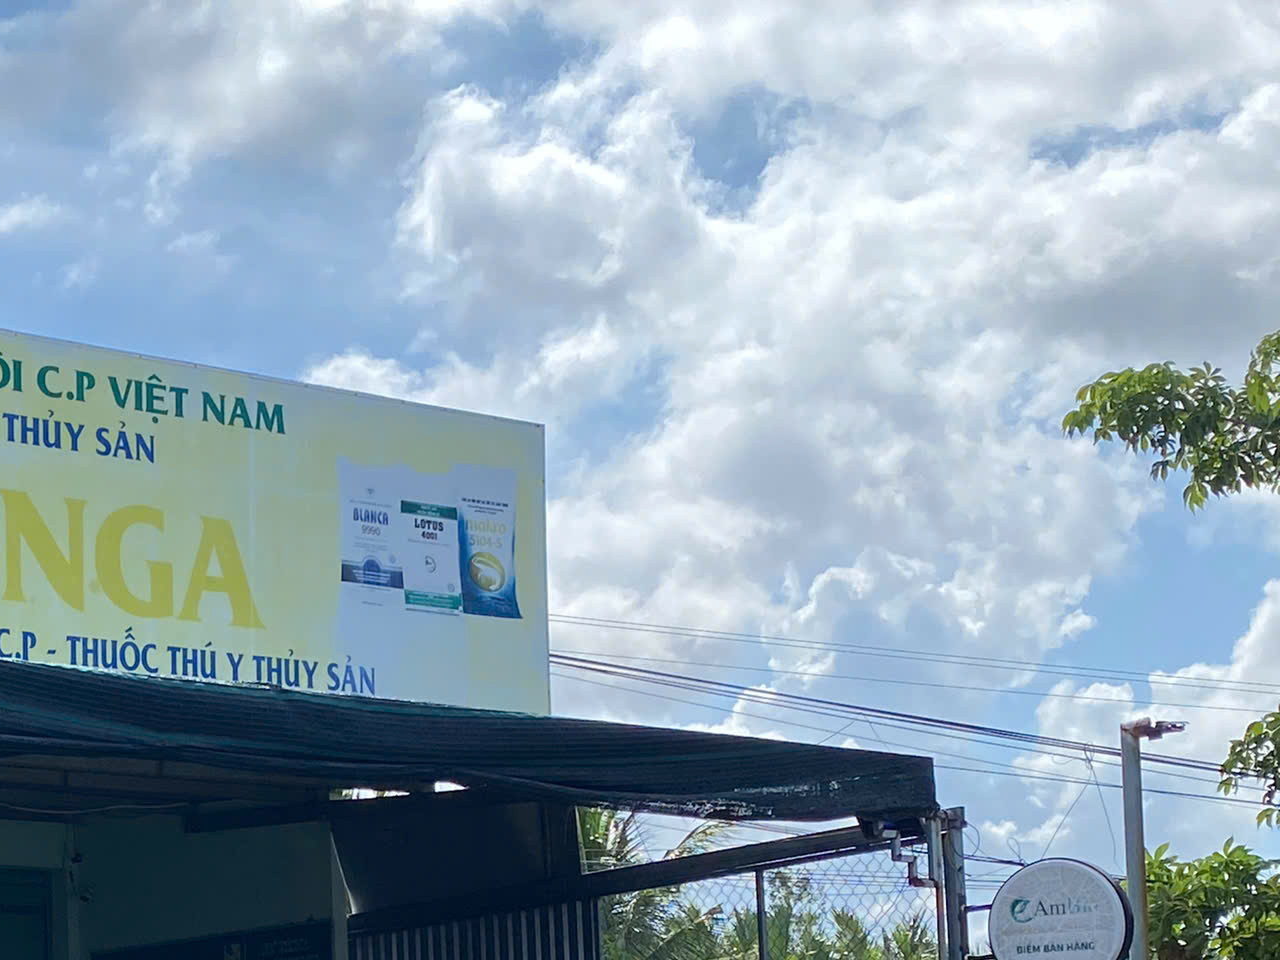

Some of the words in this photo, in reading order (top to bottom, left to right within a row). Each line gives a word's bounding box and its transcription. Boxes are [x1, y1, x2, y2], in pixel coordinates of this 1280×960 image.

[36, 364, 96, 403] C.P
[108, 373, 189, 424] VIỆT
[201, 391, 286, 435] NAM
[6, 408, 85, 452] THỦY
[94, 421, 156, 463] SẢN
[414, 518, 445, 532] LOTUS
[66, 626, 159, 674] THUỐC
[167, 641, 216, 678] THÚ
[227, 652, 244, 682] Y
[253, 649, 319, 690] THỦY
[327, 655, 376, 695] SẢN
